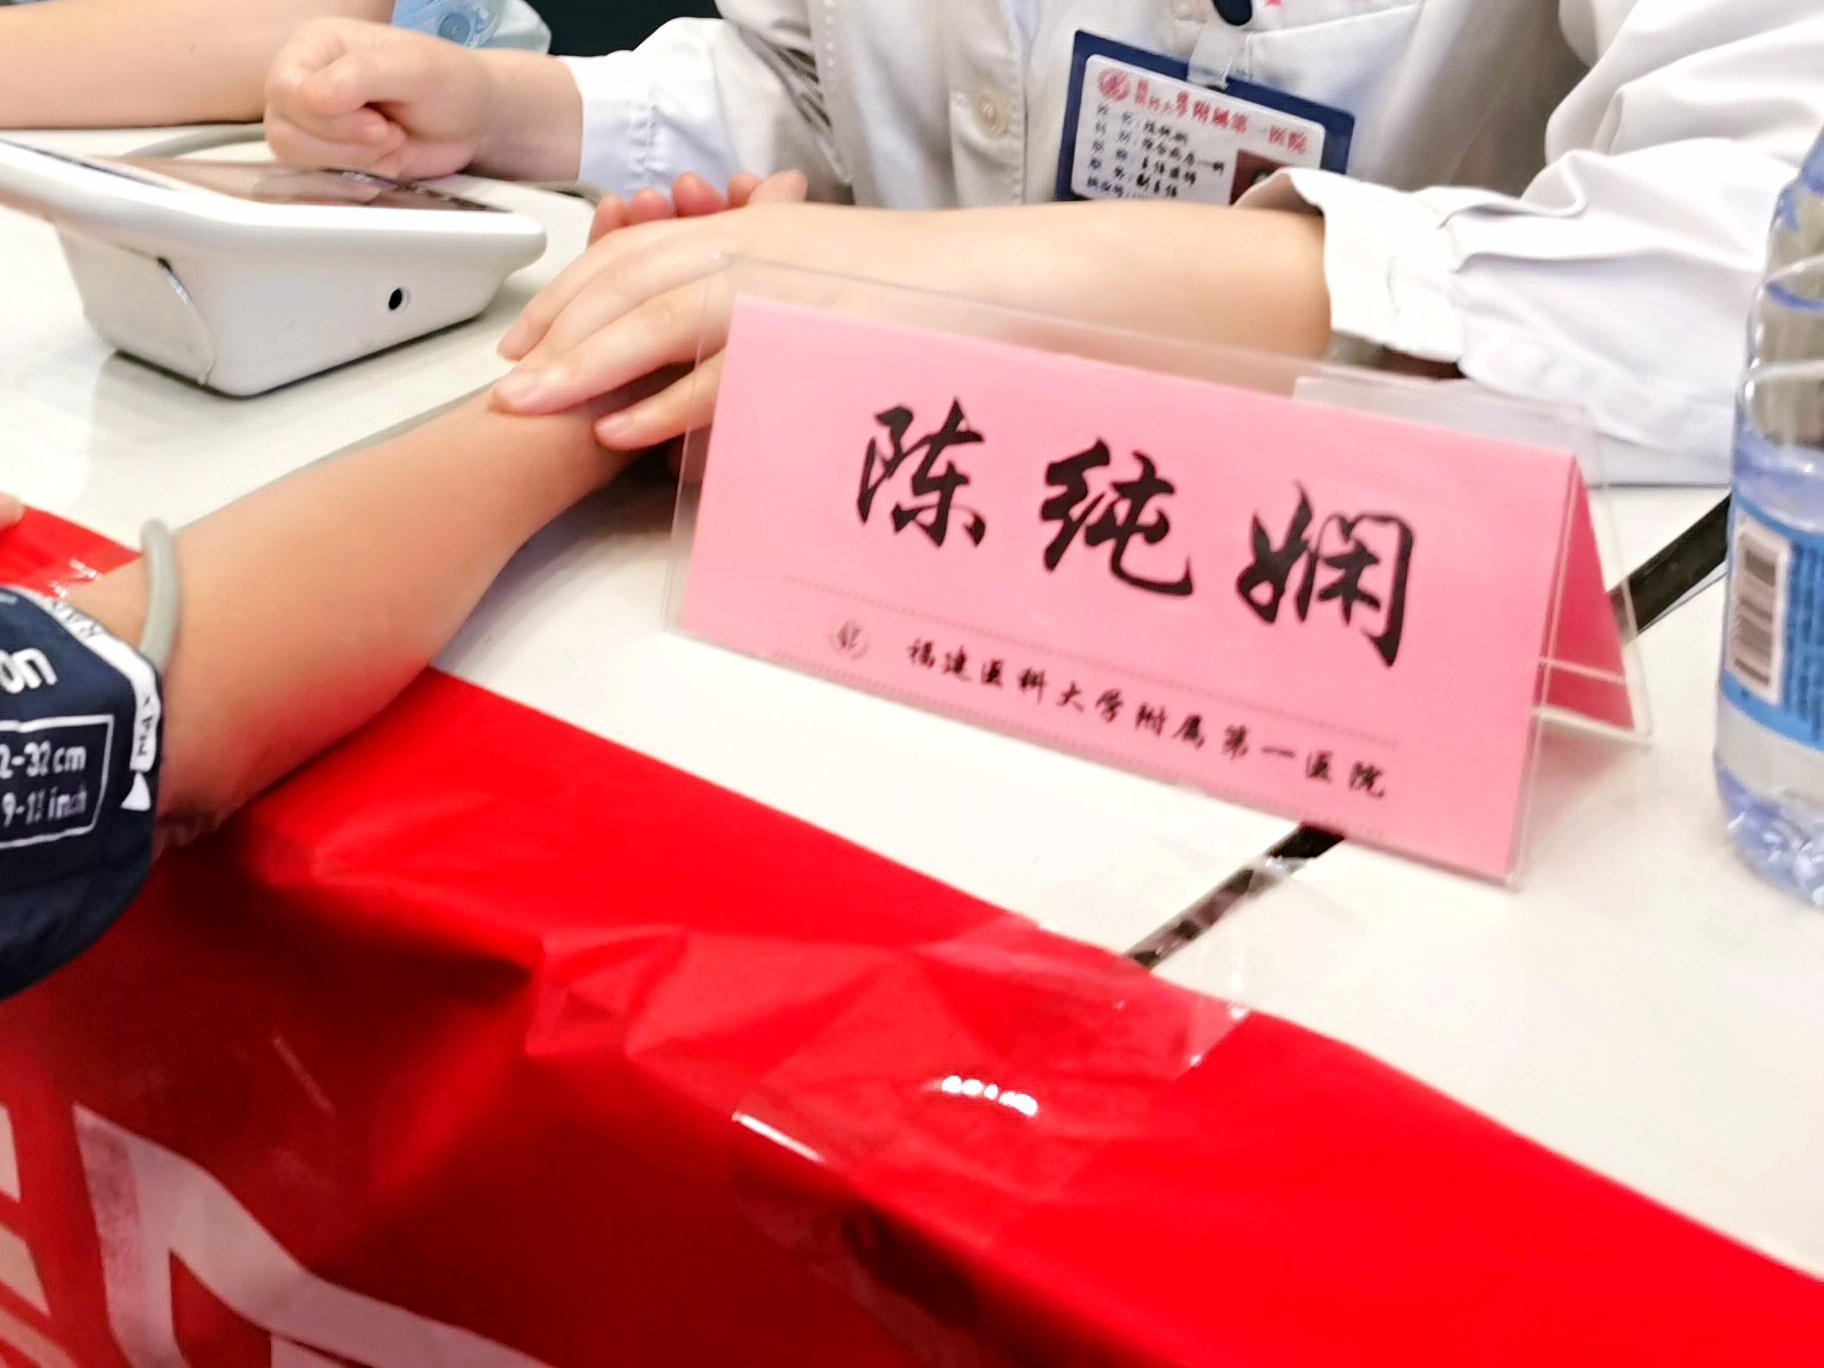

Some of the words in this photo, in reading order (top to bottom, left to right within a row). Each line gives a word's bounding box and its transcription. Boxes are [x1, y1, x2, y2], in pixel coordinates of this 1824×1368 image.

[856, 397, 1414, 668] 陈纯娴
[52, 745, 87, 774] cm
[907, 637, 1385, 798] 福建医科大学附属第一医院
